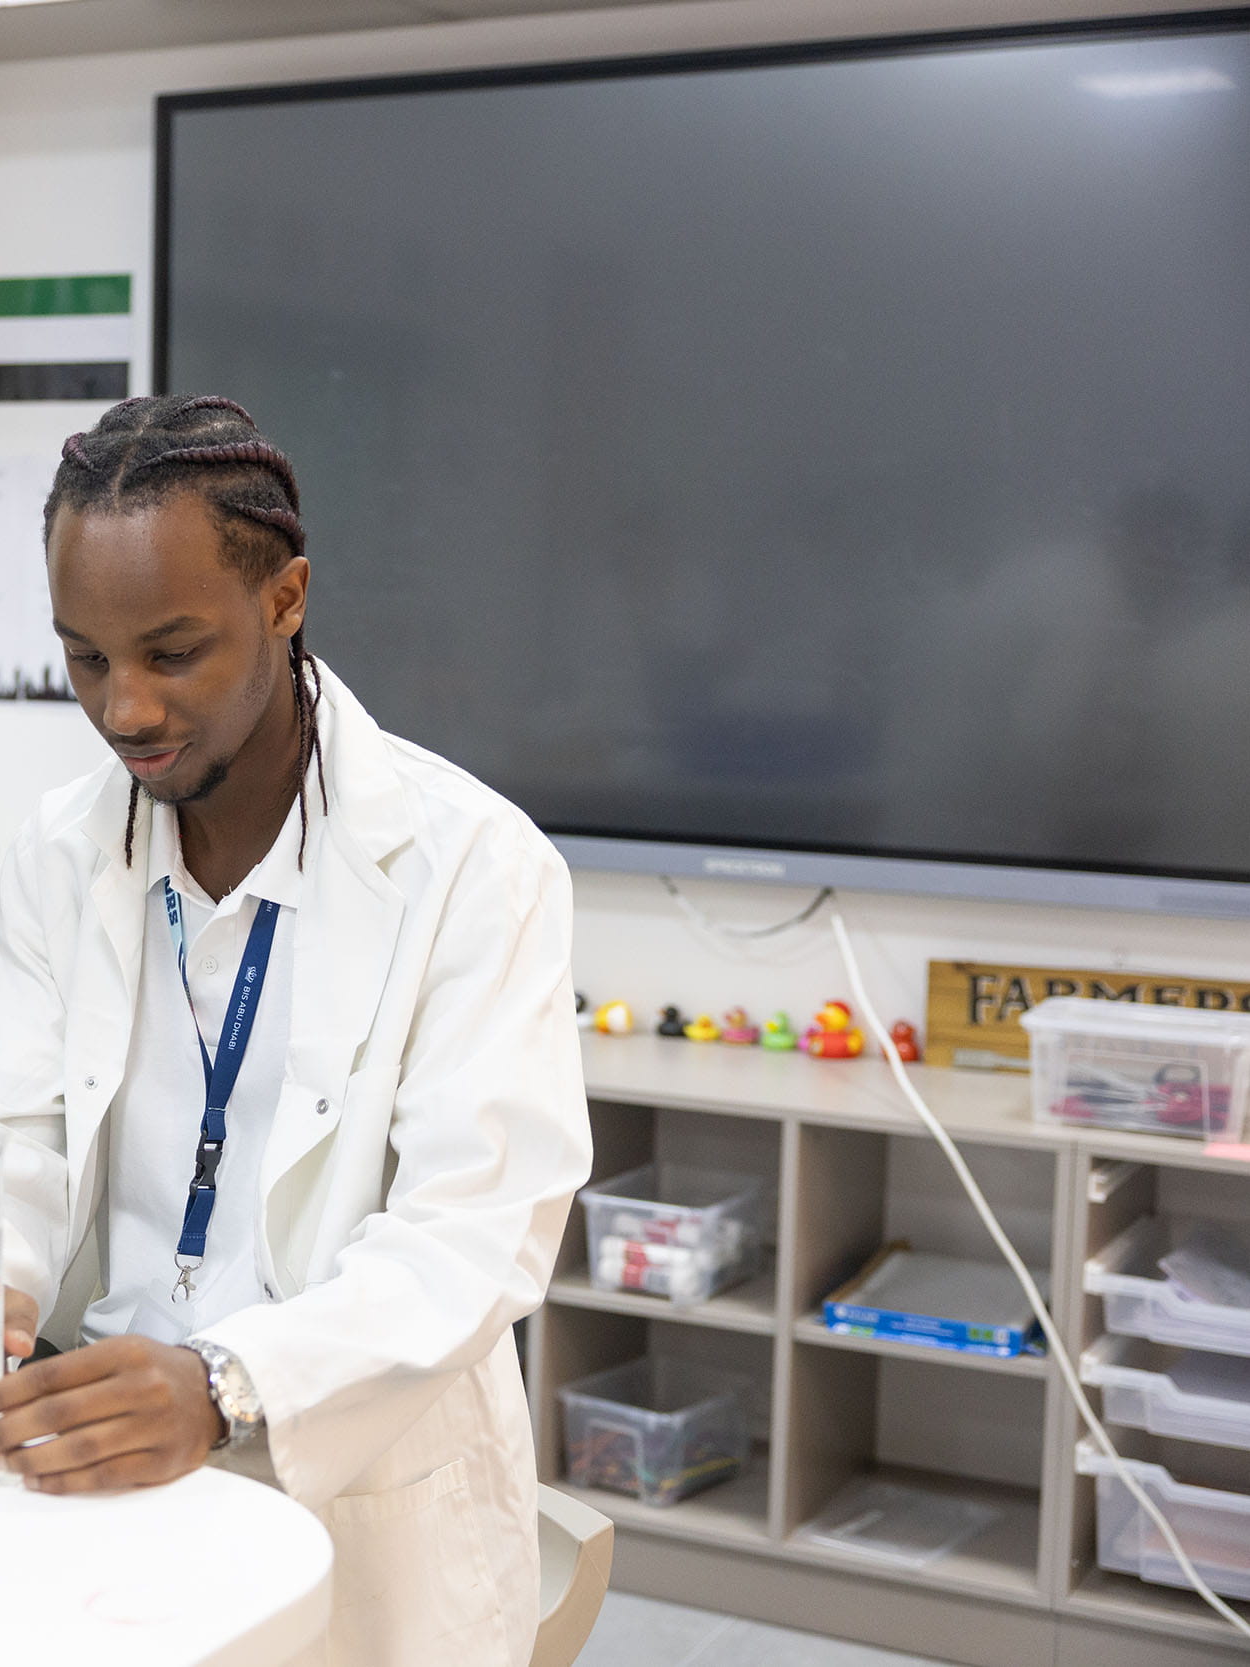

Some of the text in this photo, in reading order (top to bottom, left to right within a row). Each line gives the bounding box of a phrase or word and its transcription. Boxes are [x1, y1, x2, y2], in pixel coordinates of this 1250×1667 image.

[227, 985, 251, 1050] BIS ABU DHABI
